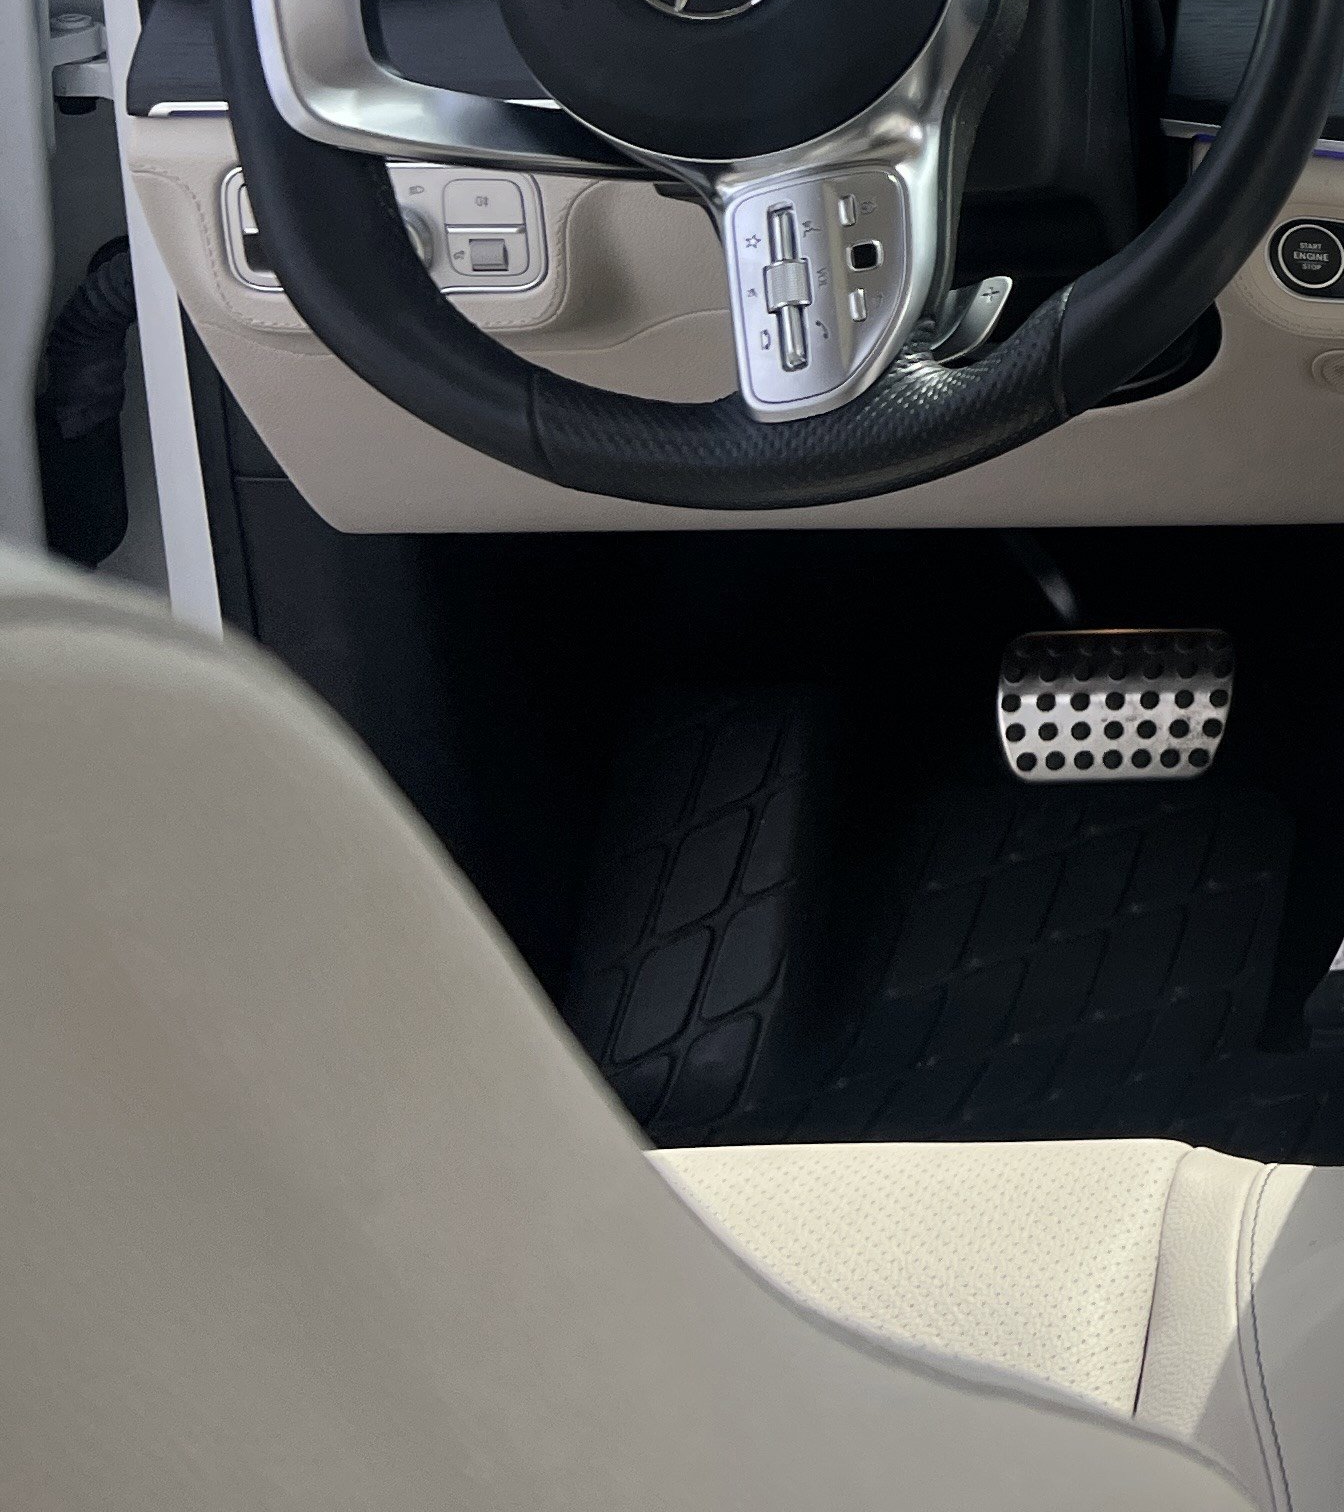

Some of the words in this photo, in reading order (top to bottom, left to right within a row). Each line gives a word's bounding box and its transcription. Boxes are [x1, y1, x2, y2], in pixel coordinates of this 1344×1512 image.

[1299, 242, 1322, 250] START
[1293, 251, 1330, 262] ENGINE
[1302, 263, 1322, 271] STOP
